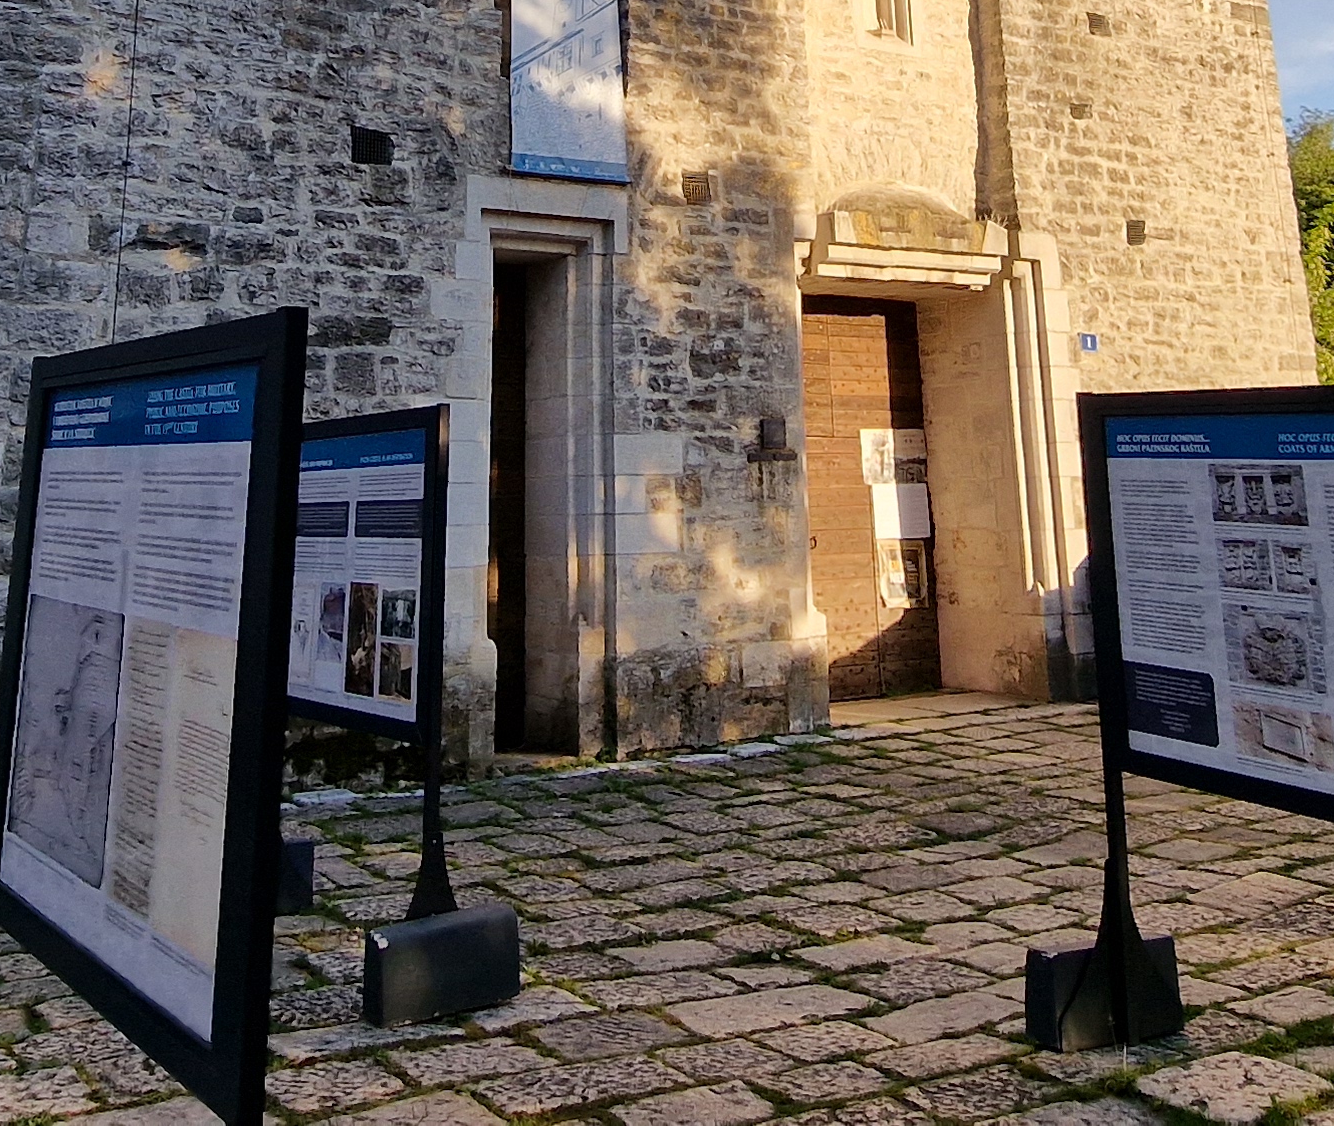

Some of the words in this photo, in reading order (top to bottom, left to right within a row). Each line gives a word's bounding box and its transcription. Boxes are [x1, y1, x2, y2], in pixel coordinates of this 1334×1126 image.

[1086, 336, 1093, 349] 1
[1277, 433, 1296, 442] HOC
[1297, 433, 1321, 442] OPUS
[1278, 444, 1305, 454] COATS
[1306, 444, 1317, 454] OF
